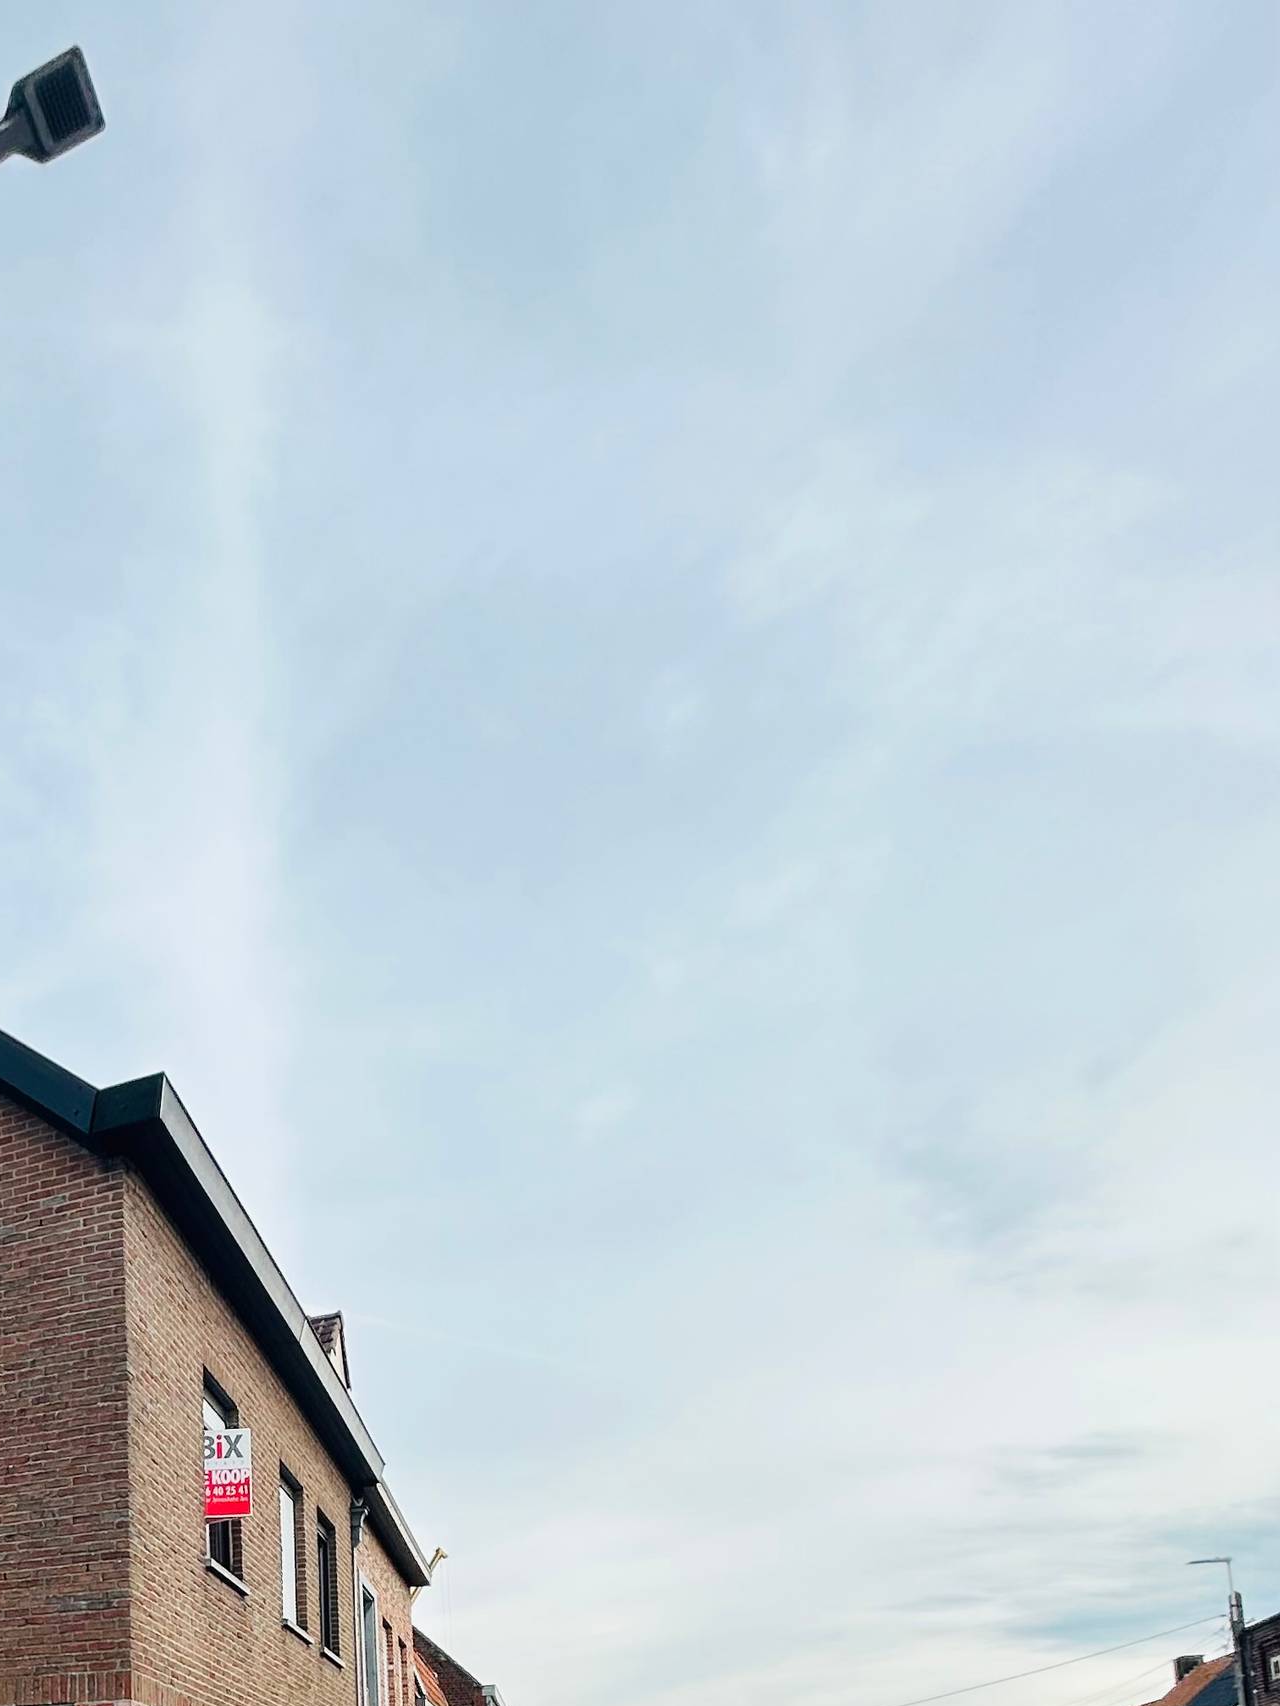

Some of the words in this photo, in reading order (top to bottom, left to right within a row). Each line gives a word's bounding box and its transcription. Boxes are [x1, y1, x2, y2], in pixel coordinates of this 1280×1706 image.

[211, 1469, 249, 1485] KOOP
[213, 1486, 224, 1496] 40
[225, 1486, 236, 1496] 25
[238, 1485, 248, 1495] 41
